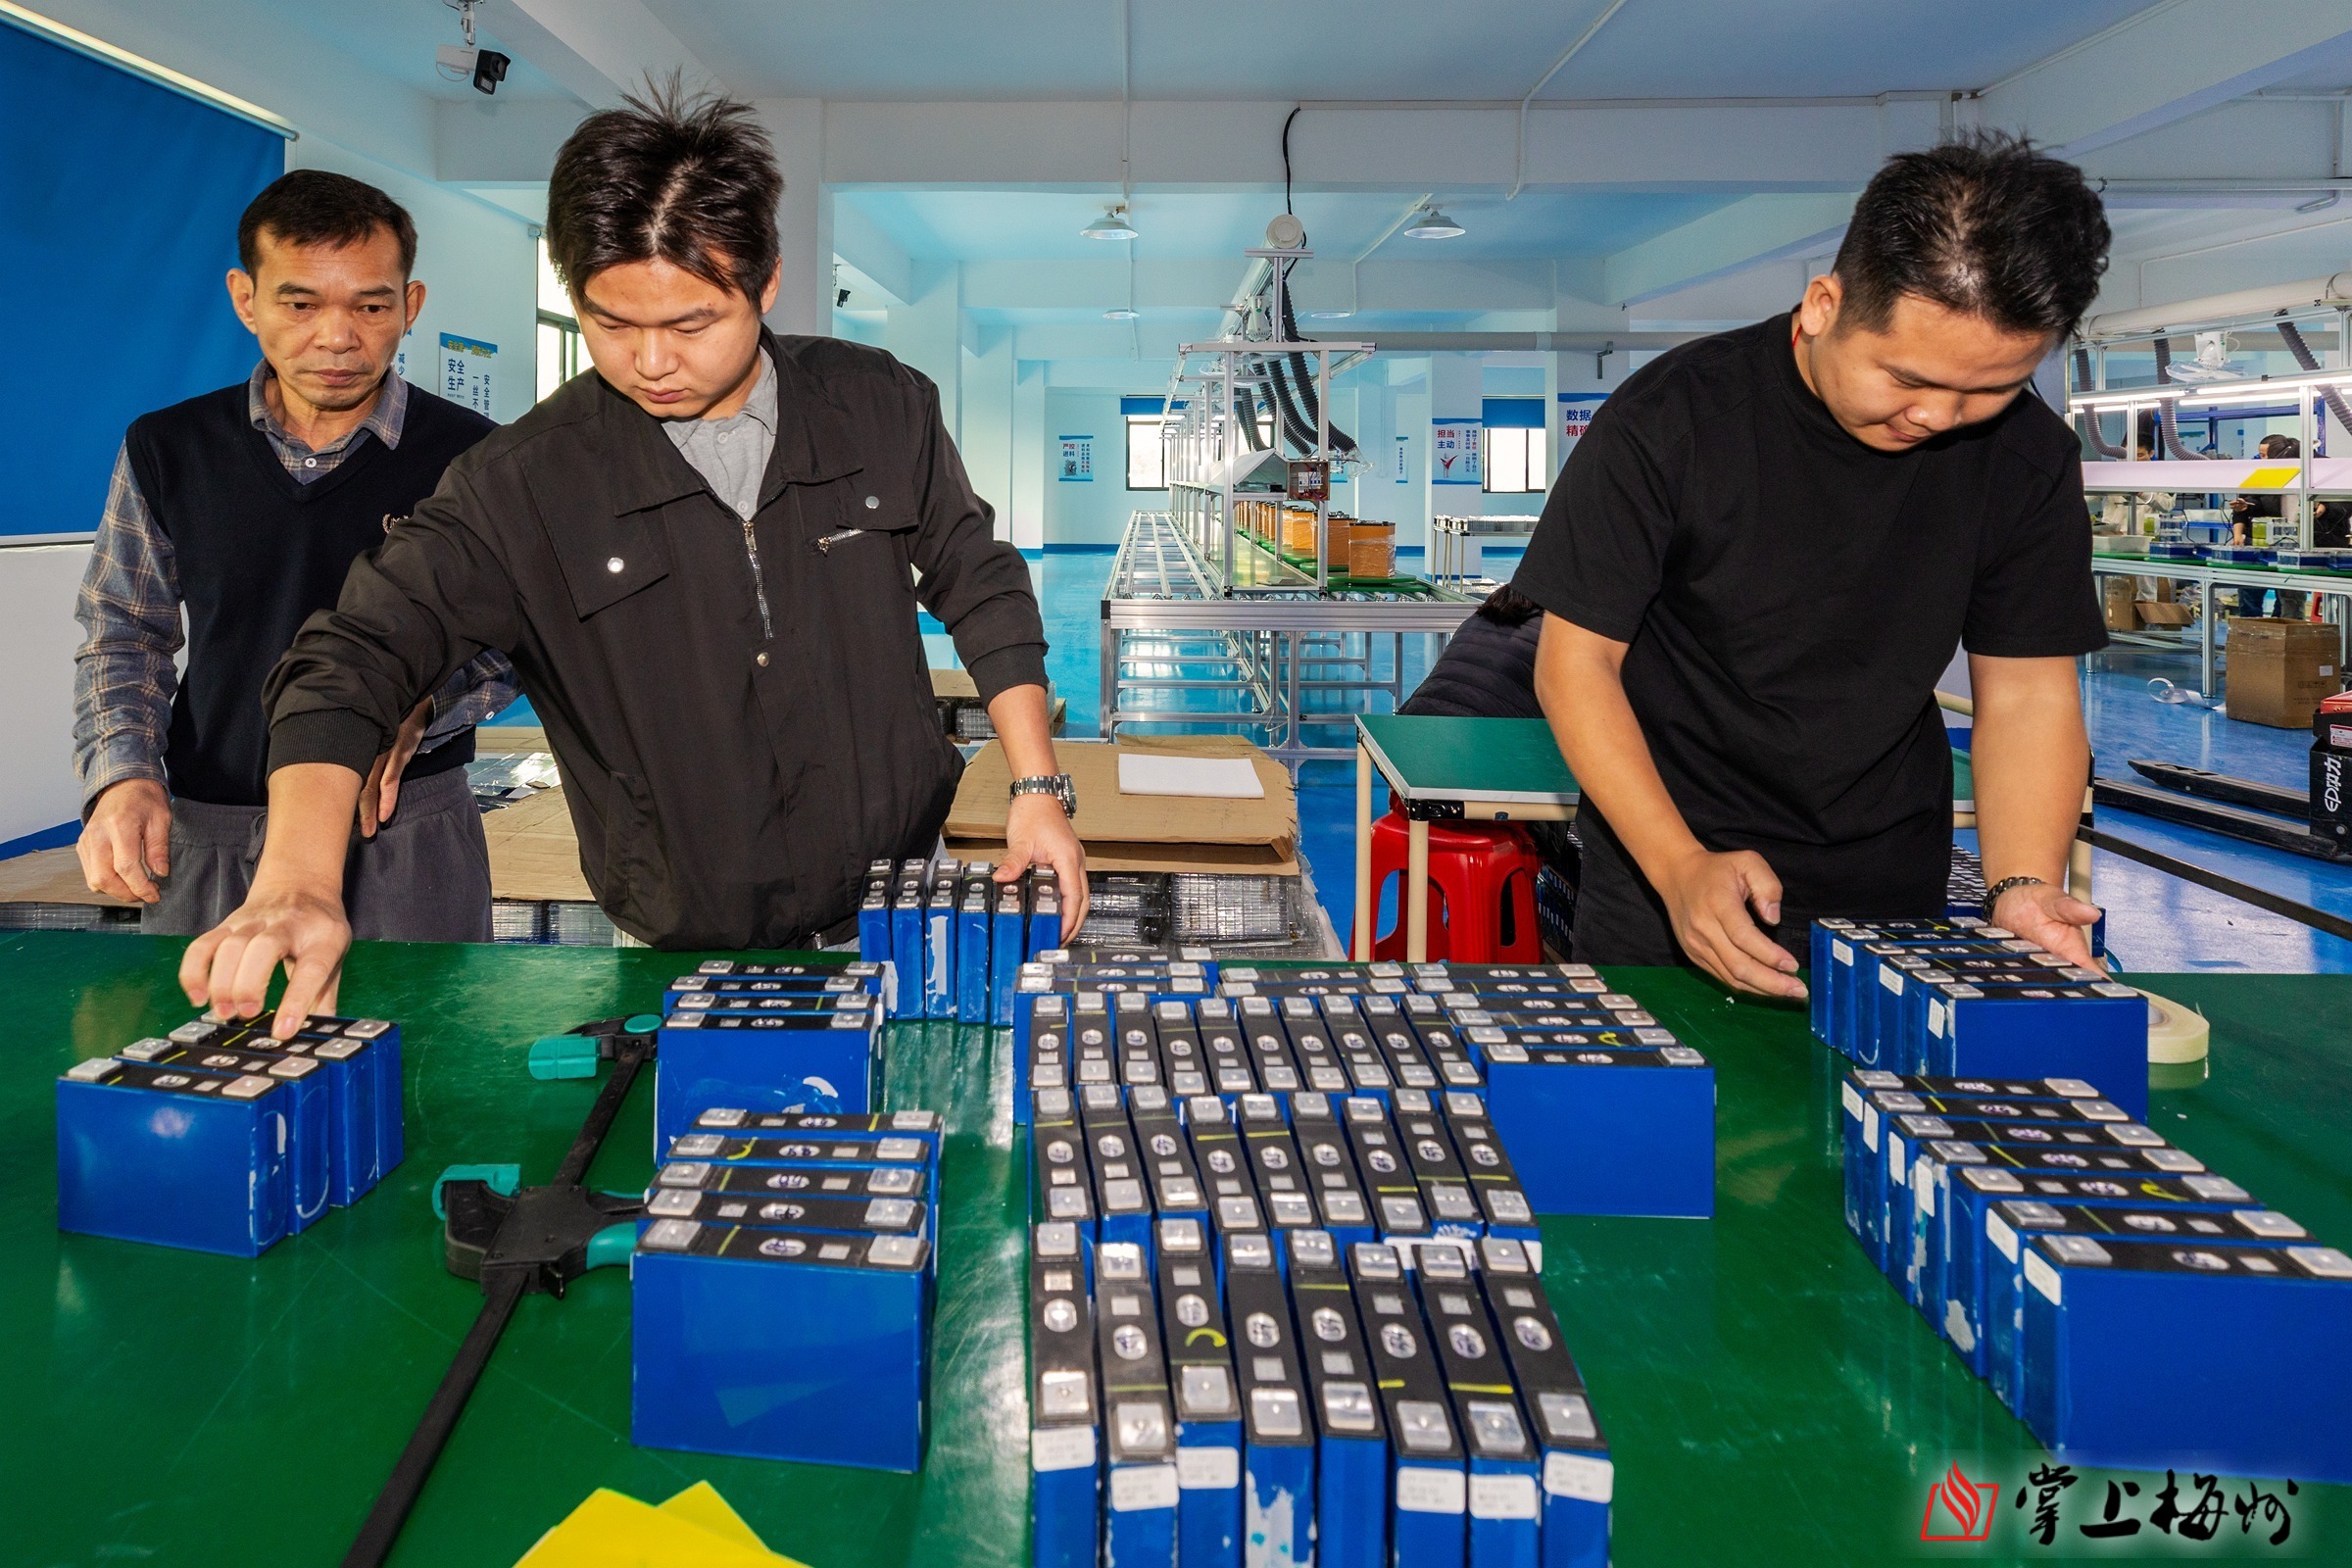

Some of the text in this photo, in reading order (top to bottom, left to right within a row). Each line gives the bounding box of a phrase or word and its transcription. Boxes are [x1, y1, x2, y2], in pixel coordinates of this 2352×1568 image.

[448, 358, 465, 374] 安全
[448, 375, 465, 391] 生产
[1566, 409, 1592, 421] 数据
[1437, 429, 1455, 438] 担当
[1437, 440, 1455, 449] 主动
